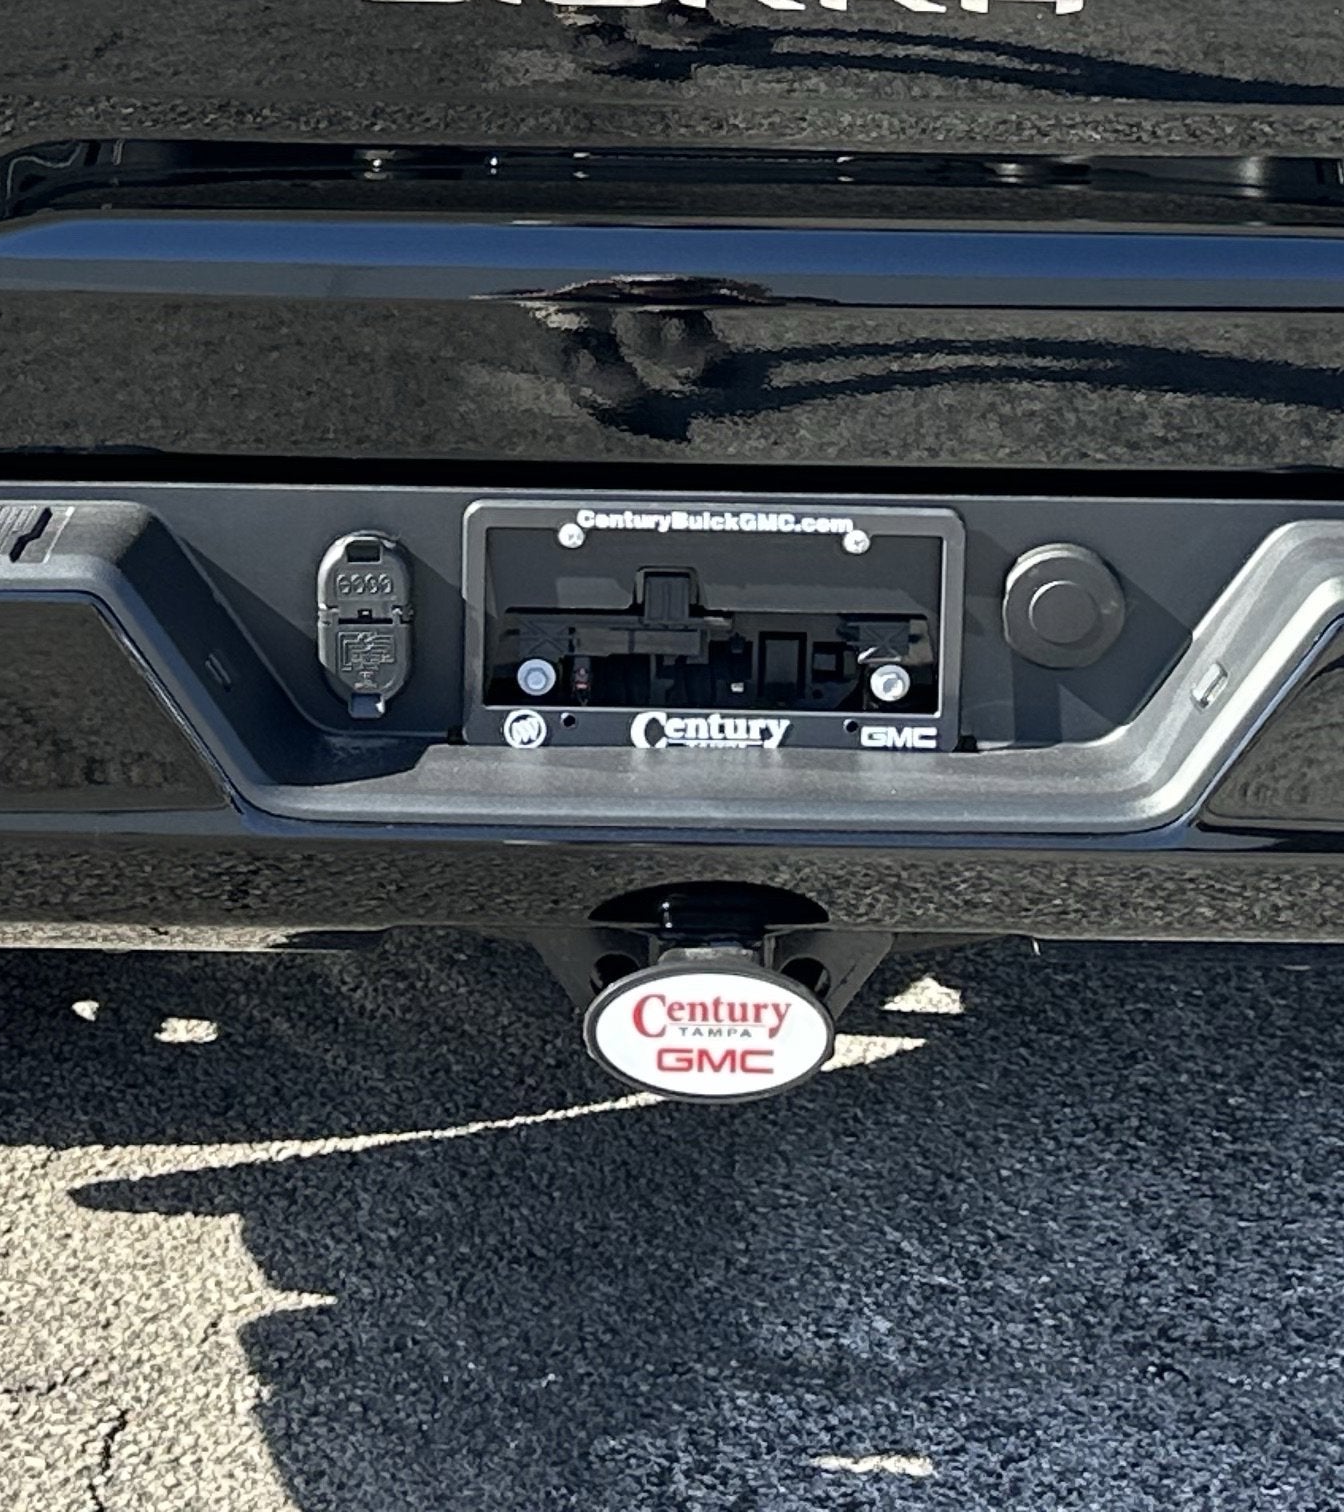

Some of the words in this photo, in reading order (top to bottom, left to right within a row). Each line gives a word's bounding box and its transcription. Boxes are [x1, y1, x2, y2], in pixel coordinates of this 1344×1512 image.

[577, 509, 854, 533] CenturyBuickGMC.com
[630, 711, 789, 748] Century
[860, 726, 937, 748] GMC
[632, 994, 792, 1038] Century
[679, 1027, 752, 1037] TAMPA
[657, 1048, 774, 1074] GMC
